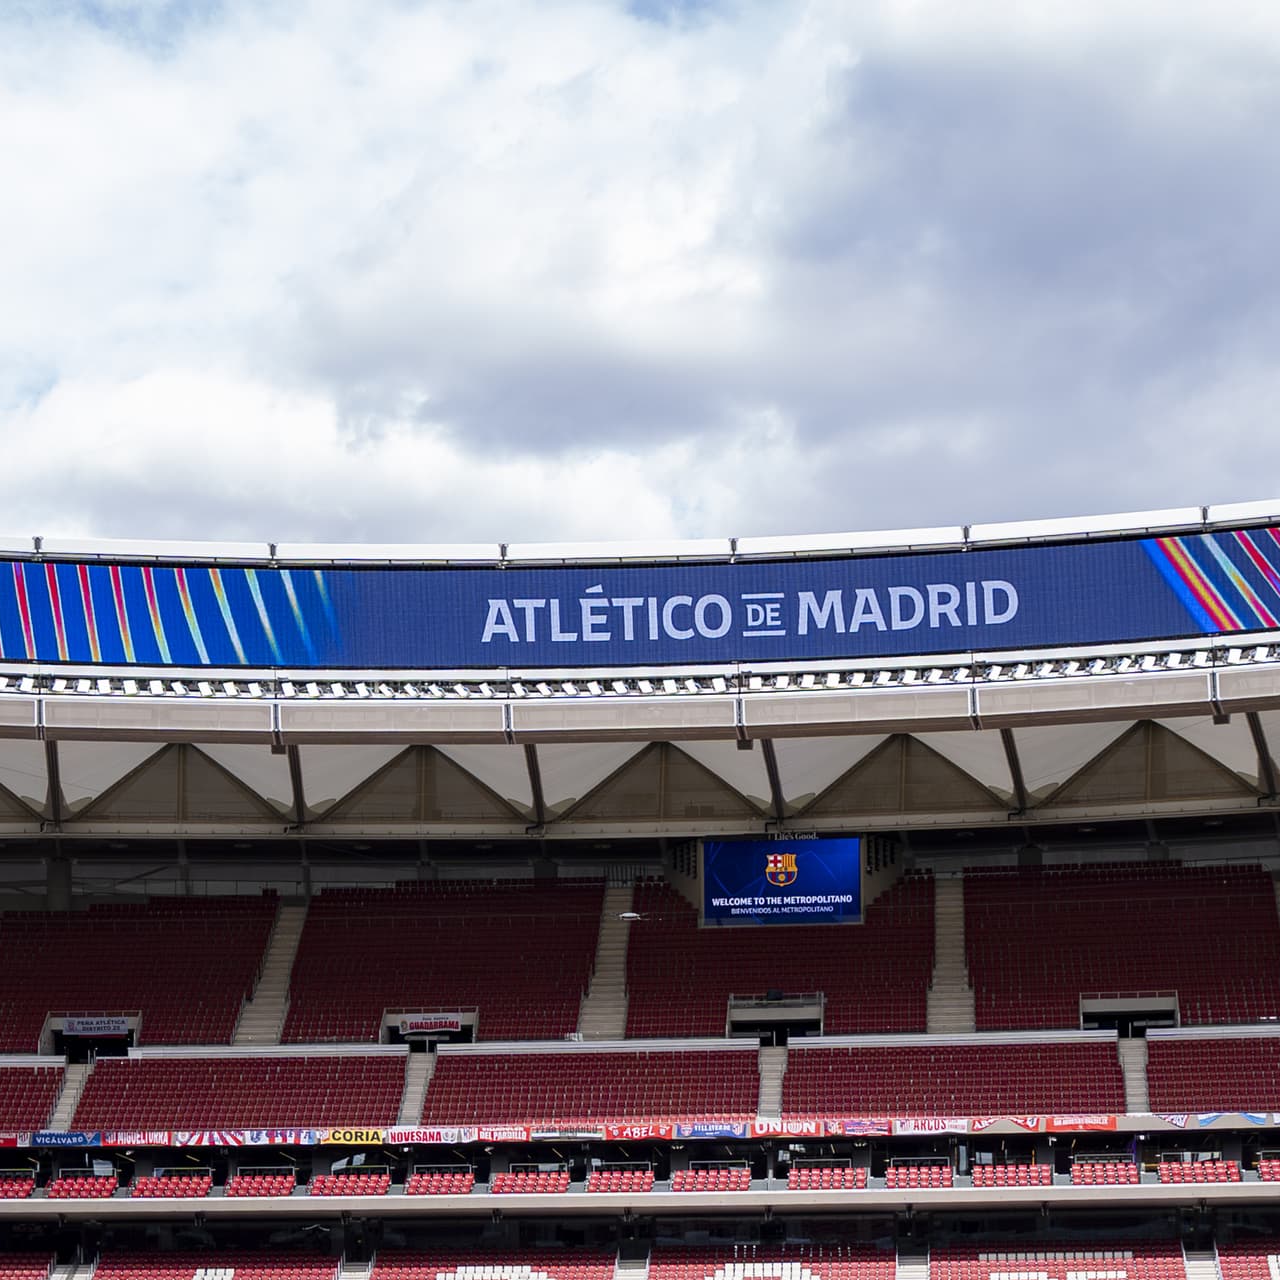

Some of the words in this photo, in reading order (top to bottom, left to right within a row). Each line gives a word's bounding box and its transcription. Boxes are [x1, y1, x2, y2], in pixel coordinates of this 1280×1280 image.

[481, 584, 732, 643] ATLÉTICO
[746, 602, 782, 626] DE
[798, 580, 1019, 635] MADRID
[712, 897, 752, 906] WELCOME
[754, 897, 765, 906] TO
[766, 896, 782, 905] THE
[783, 895, 853, 905] METROPOLITANO
[731, 906, 772, 915] BIENVENIDOS
[773, 906, 781, 914] AL
[781, 905, 834, 914] METROPOLITANO
[332, 1130, 381, 1142] CORIA
[390, 1130, 441, 1143] NOVESANA
[622, 1125, 656, 1138] ABEL
[36, 1132, 84, 1145] VICÁLVARO
